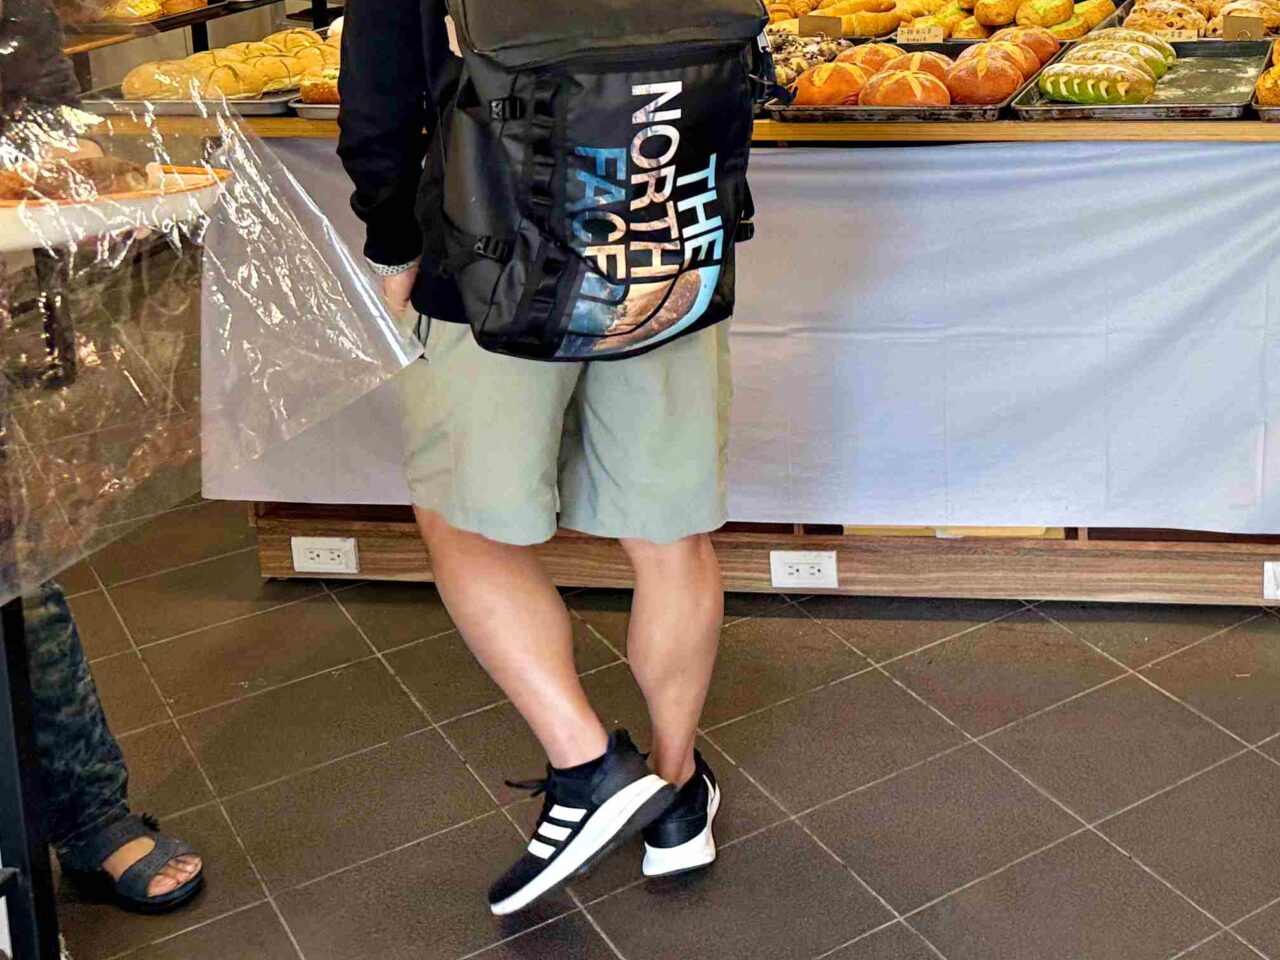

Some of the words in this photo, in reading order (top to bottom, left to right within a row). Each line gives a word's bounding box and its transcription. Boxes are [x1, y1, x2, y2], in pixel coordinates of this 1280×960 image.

[569, 146, 627, 279] FACE
[630, 80, 683, 279] NORTH
[676, 152, 725, 272] THE
